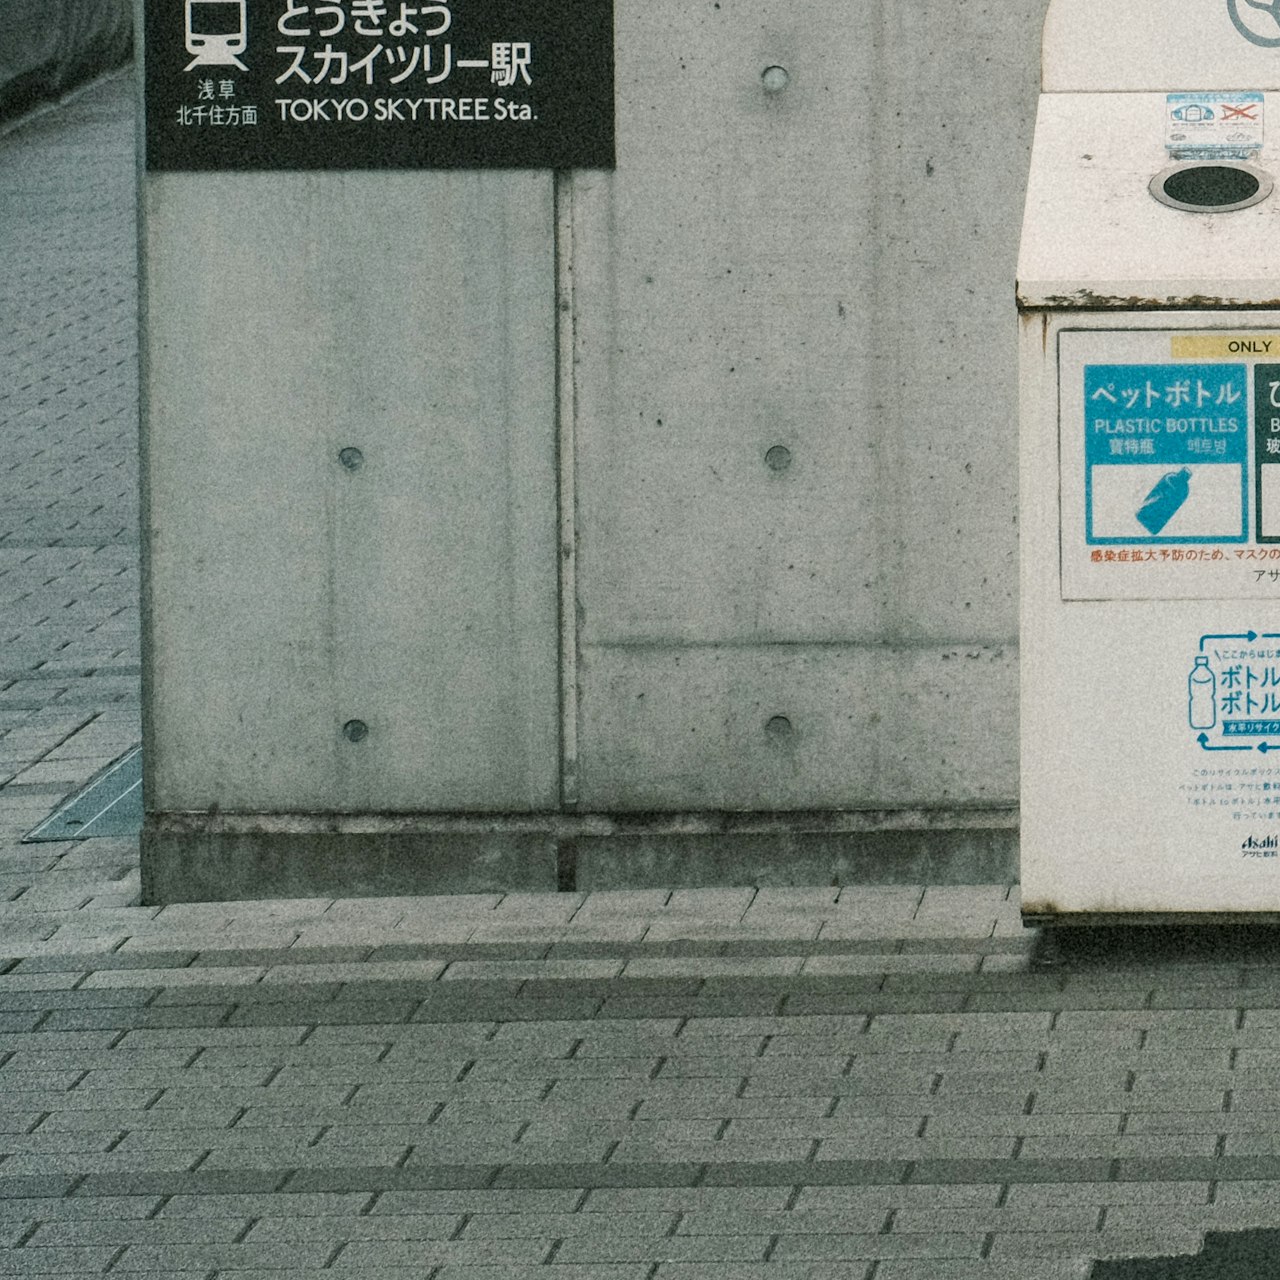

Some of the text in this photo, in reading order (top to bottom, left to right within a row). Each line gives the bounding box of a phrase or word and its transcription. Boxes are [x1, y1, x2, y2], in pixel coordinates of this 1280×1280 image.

[275, 42, 533, 86] スカイツリー駅
[196, 79, 236, 100] 浅草
[176, 103, 258, 126] 北千住方面
[275, 98, 538, 121] TOKYO SKYTREE Sta.
[1228, 341, 1272, 353] ONLY
[1092, 380, 1241, 408] ペットボトル
[1095, 418, 1238, 434] PLASTIC BOTTLES
[1241, 834, 1279, 850] Asahi
